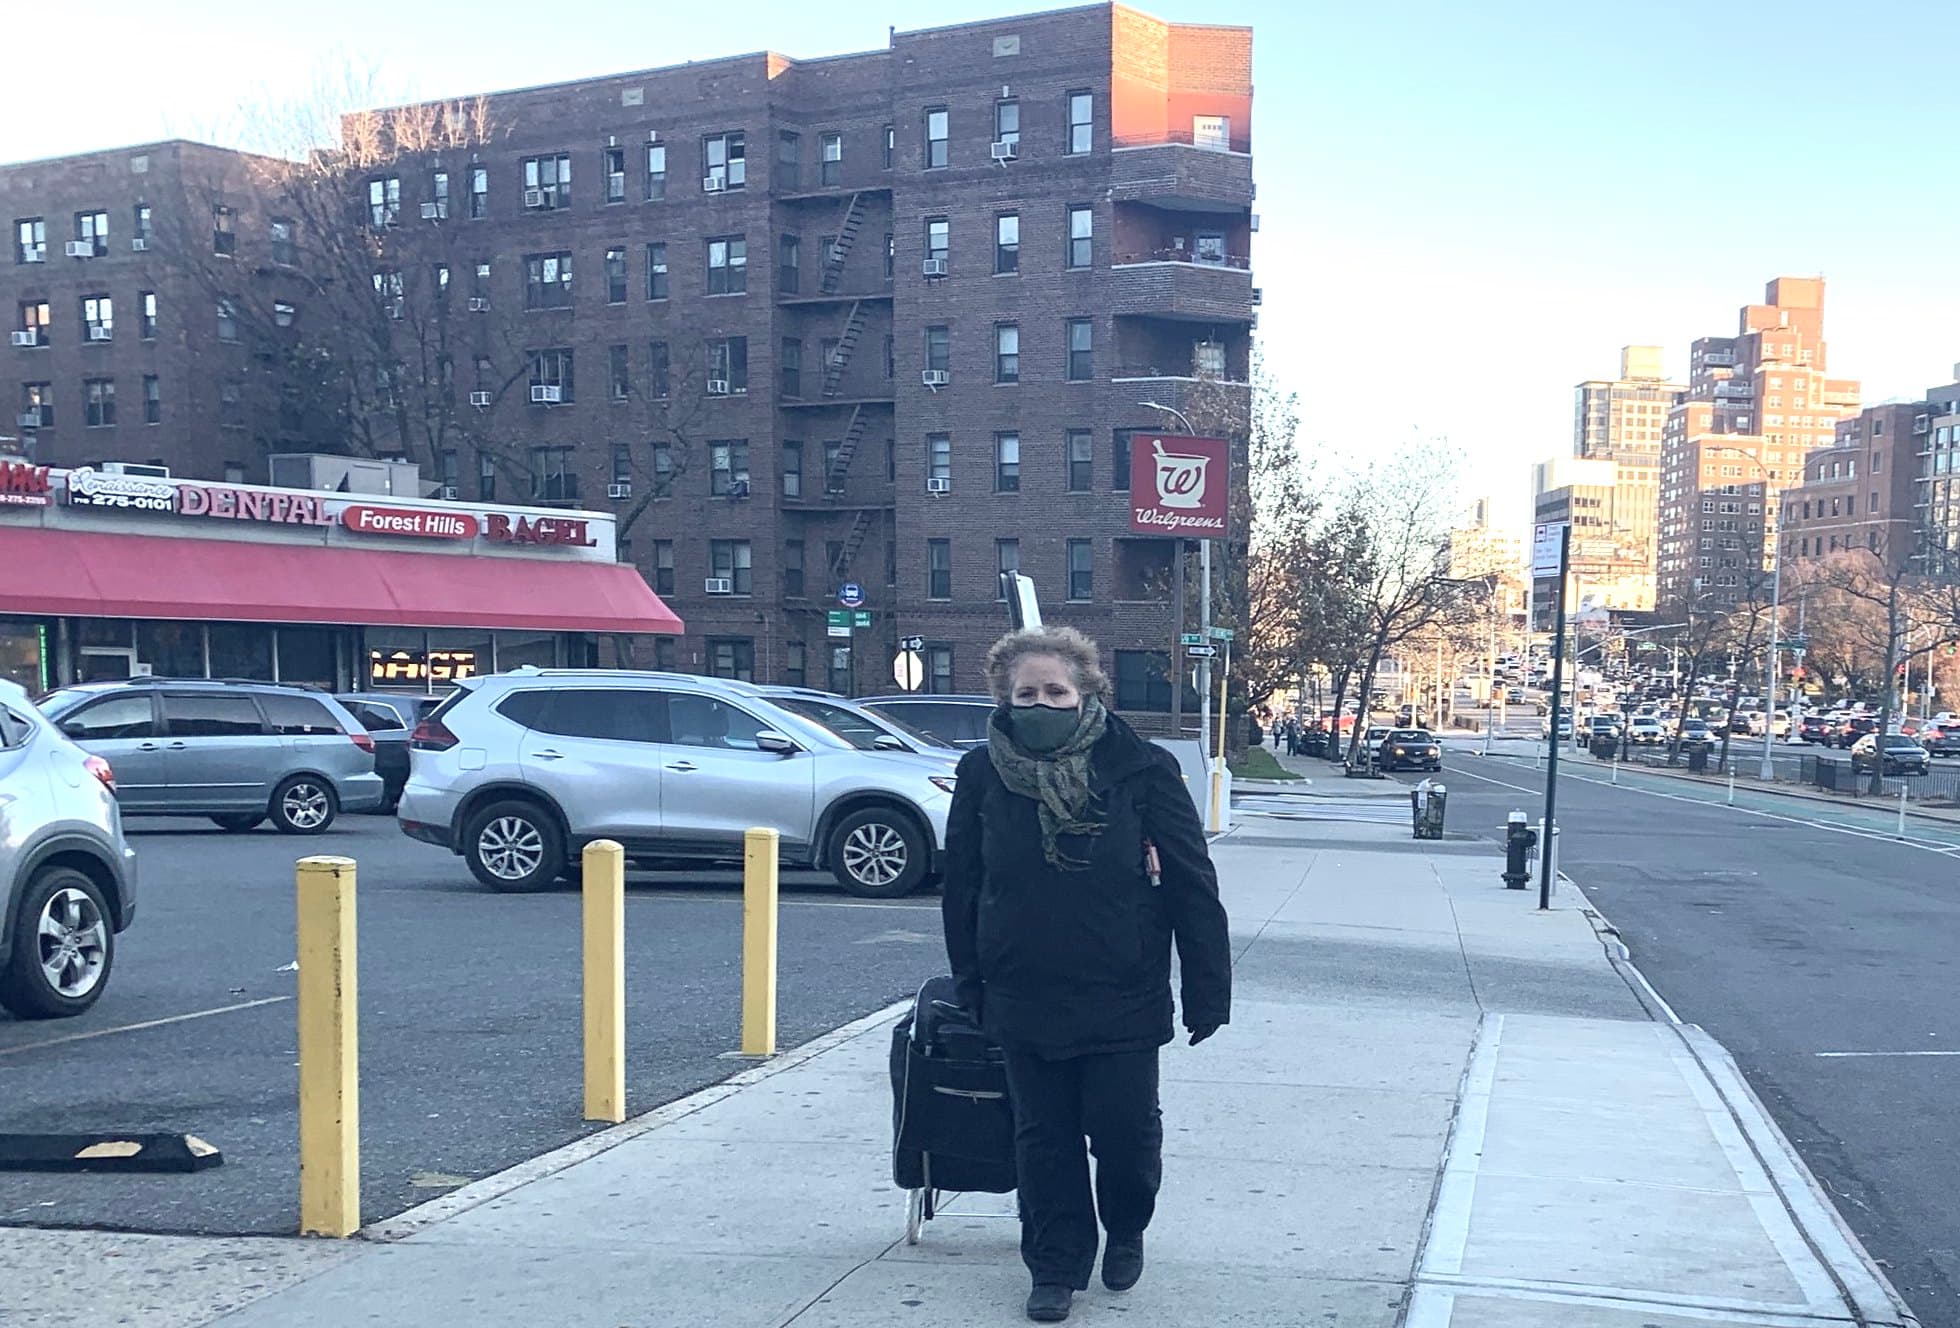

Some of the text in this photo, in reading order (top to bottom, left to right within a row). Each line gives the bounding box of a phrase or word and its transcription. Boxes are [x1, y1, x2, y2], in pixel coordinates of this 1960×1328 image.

[70, 468, 173, 498] Renaissance
[92, 494, 172, 511] 275-0101
[178, 485, 336, 526] DENTAL
[359, 510, 597, 547] Forest Hills BAGEL
[1135, 508, 1224, 530] Walgreens
